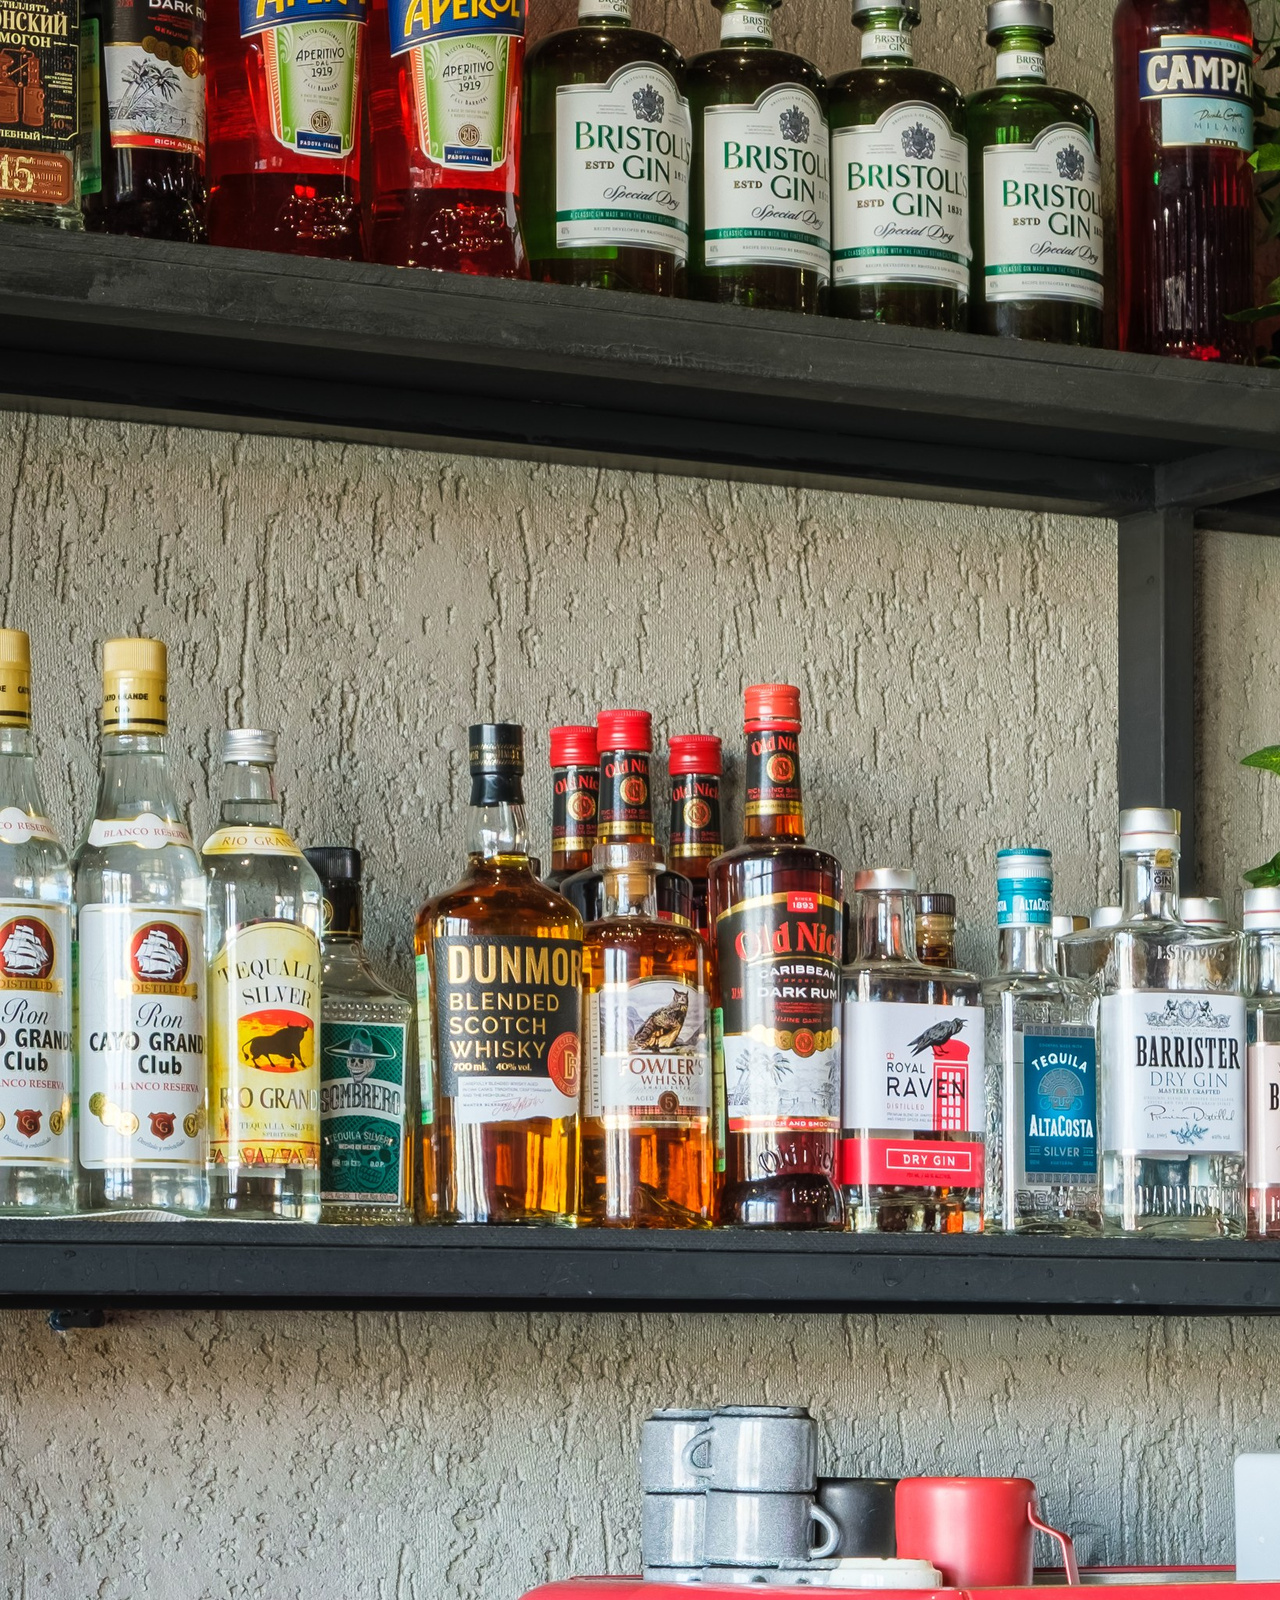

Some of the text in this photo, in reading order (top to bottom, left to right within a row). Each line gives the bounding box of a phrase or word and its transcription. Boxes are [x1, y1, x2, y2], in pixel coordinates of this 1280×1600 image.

[0, 10, 68, 37] НСКИЙ
[296, 47, 344, 62] APERITIVO
[889, 44, 905, 52] GIN
[311, 66, 333, 78] 1919
[443, 61, 495, 78] APERITIVO
[1147, 54, 1251, 96] CAMPA
[459, 80, 481, 93] 1919
[1194, 122, 1245, 135] MILANO
[155, 138, 174, 147] RICH
[575, 121, 691, 168] BRISTOLL'S
[585, 155, 671, 185] ESTD GIN
[847, 161, 969, 199] BRISTOLL'S
[603, 185, 681, 211] Special Dry
[733, 175, 815, 205] ESTD GIN
[857, 192, 943, 219] ESTD GIN
[574, 211, 594, 221] CLASSIC
[751, 205, 824, 231] Special Dry
[874, 222, 954, 245] Special Dry
[1012, 212, 1091, 241] ESTD GIN
[1029, 241, 1099, 265] Special Dry
[751, 735, 776, 757] Old
[605, 759, 629, 779] Old
[672, 782, 693, 802] Old
[103, 827, 149, 838] BLANCO
[221, 835, 249, 847] RIO
[1154, 876, 1171, 885] GIN
[792, 902, 814, 910] 1893
[735, 921, 791, 963] Old
[447, 944, 581, 989] DUNMOR
[760, 965, 837, 983] CARIBBEAN
[131, 983, 187, 996] DISTILLED
[242, 985, 312, 1009] SILVER
[757, 987, 838, 1000] DARK RUM
[2, 997, 50, 1026] Ron
[449, 992, 560, 1013] BLENDED
[134, 1001, 184, 1029] Ron
[449, 1017, 547, 1036] SCOTCH
[89, 1031, 140, 1053] CAYO
[449, 1040, 547, 1060] WHISKY
[1135, 1035, 1241, 1069] BARRISTER
[3, 1051, 49, 1073] Club
[137, 1054, 182, 1075] Club
[453, 1062, 532, 1072] 700 40% vol.
[619, 1057, 704, 1077] FOWLER'S
[886, 1062, 926, 1074] ROYAL
[1032, 1052, 1089, 1075] TEQUILA
[163, 1081, 200, 1094] RESERVA
[641, 1075, 692, 1086] WHISKY
[886, 1076, 966, 1100] RAVEN
[1150, 1071, 1228, 1088] DRY GIN
[321, 1082, 400, 1116] SOMBRERO
[886, 1102, 925, 1111] DISTILLED
[1029, 1114, 1094, 1139] ALTACOSTA
[329, 1131, 392, 1146] TEQUILA SILVER
[903, 1154, 956, 1166] DRY GIN
[1044, 1146, 1080, 1159] SILVER
